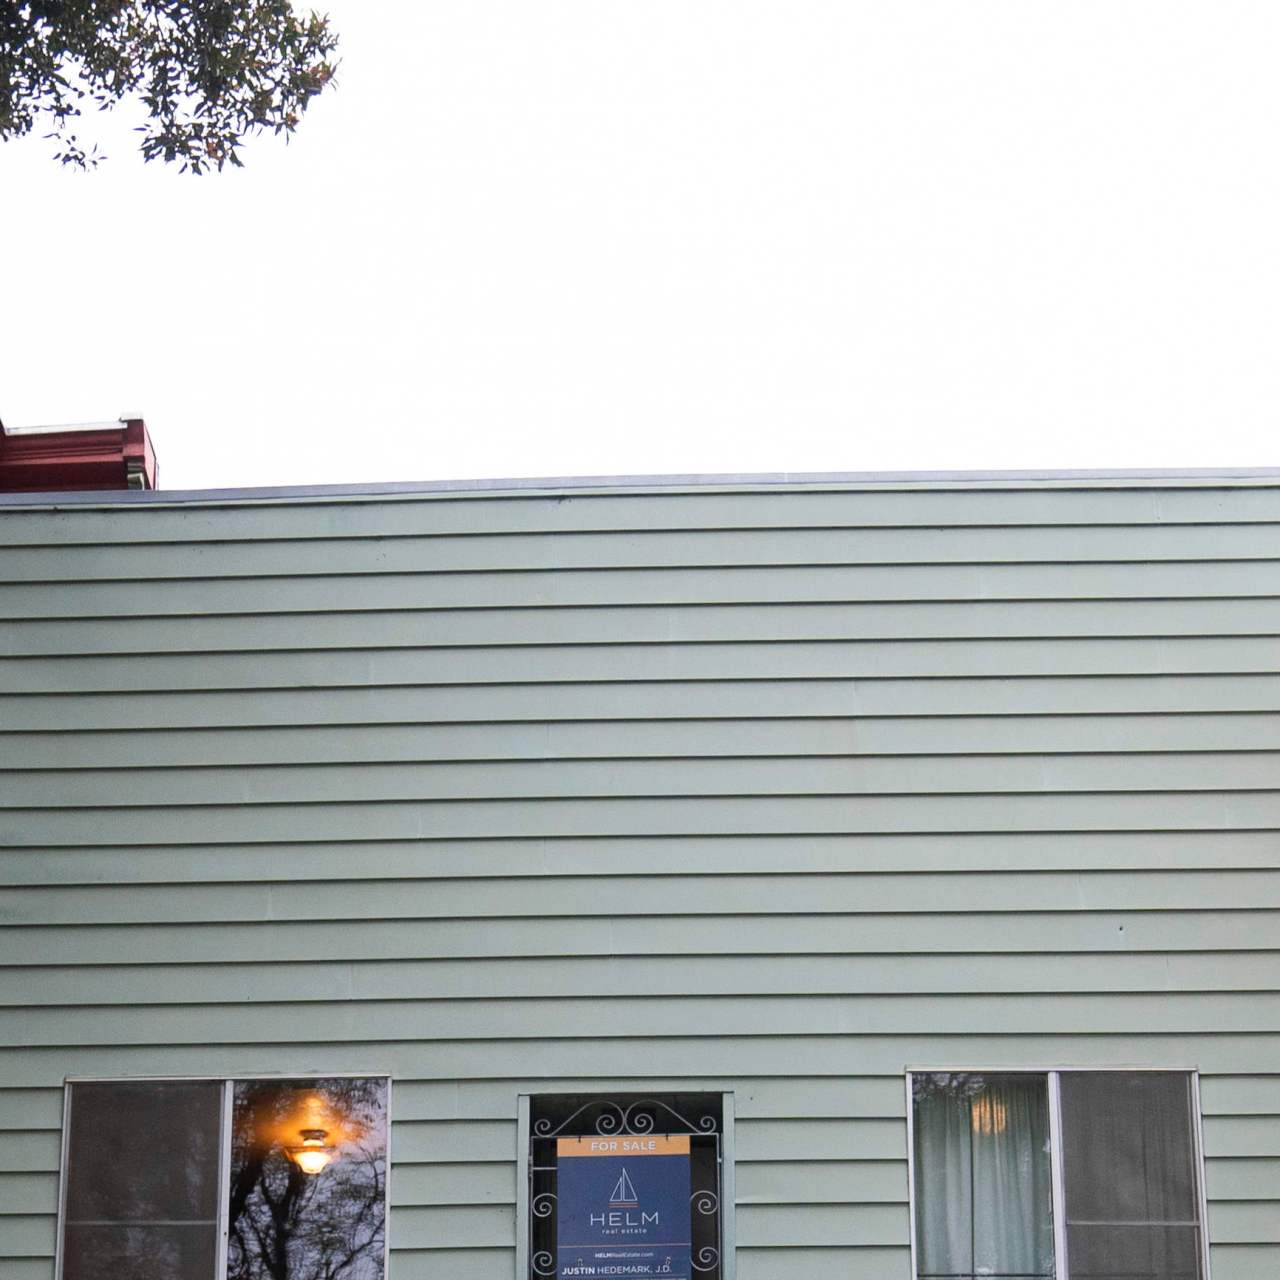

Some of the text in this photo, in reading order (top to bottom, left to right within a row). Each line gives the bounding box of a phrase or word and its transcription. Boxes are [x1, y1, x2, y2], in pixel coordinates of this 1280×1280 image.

[591, 1140, 656, 1151] FOR SALE
[590, 1211, 659, 1226] HELM
[561, 1266, 595, 1275] JUSTIN
[597, 1265, 653, 1275] HEDEMARK,
